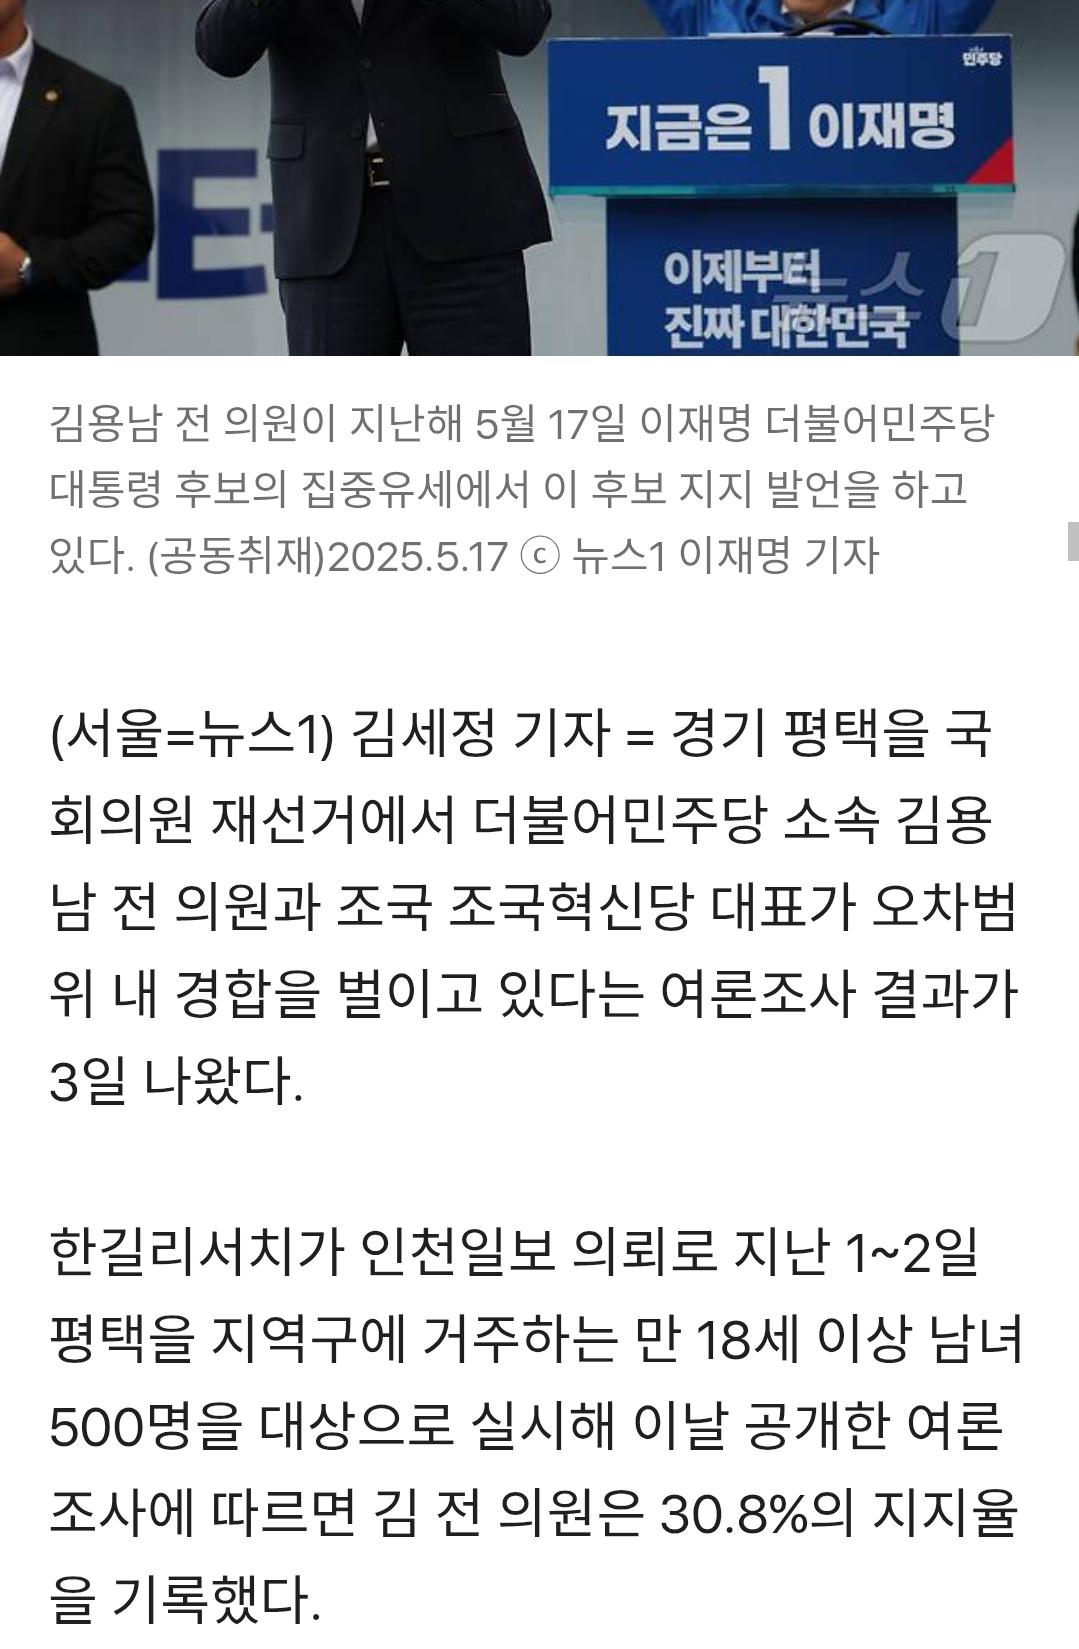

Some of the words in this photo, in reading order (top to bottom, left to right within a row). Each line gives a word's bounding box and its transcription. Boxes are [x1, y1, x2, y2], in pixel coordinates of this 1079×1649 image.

[963, 51, 1003, 66] 민주당
[605, 103, 752, 152] 지금은
[758, 65, 790, 151] 1
[808, 101, 956, 150] 이재명
[664, 248, 821, 294] 이제부터
[665, 304, 745, 349] 진짜
[750, 303, 911, 349] 대한민국
[51, 404, 163, 442] 김용남
[176, 404, 209, 442] 전
[225, 404, 334, 442] 의원이
[351, 404, 460, 442] 지난해
[477, 404, 534, 442] 5월
[549, 404, 624, 442] 17일
[642, 404, 749, 442] 이재명
[768, 404, 995, 442] 더불어민주당
[51, 470, 159, 508] 대통령
[176, 470, 285, 508] 후보의
[303, 470, 527, 508] 집중유세에서
[545, 470, 575, 508] 이
[592, 470, 666, 508] 후보
[680, 470, 750, 508] 지지
[769, 470, 879, 508] 발언을
[893, 470, 966, 508] 하고
[51, 536, 133, 574] 있다.
[149, 536, 508, 577] (공동취재)2025.5.17
[573, 538, 662, 574] 뉴스1
[681, 536, 788, 574] 이재명
[806, 536, 880, 574] 기자
[52, 708, 332, 761] (서울=뉴스1)
[353, 708, 493, 757] 김세정
[515, 708, 611, 757] 기자
[673, 708, 763, 757] 경기
[784, 708, 928, 757] 평택을
[946, 710, 991, 757] 국
[51, 795, 191, 844] 회의원
[212, 795, 452, 844] 재선거에서
[476, 795, 768, 844] 더불어민주당
[785, 796, 879, 844] 소속
[897, 795, 991, 844] 김용
[53, 882, 96, 931] 남
[112, 882, 155, 930] 전
[176, 882, 321, 931] 의원과
[338, 884, 432, 931] 조국
[450, 882, 694, 931] 조국혁신당
[713, 882, 856, 931] 대표가
[873, 882, 1014, 931] 오차범
[50, 969, 91, 1018] 위
[115, 969, 155, 1018] 내
[177, 968, 320, 1018] 경합을
[340, 969, 482, 1018] 벌이고
[500, 969, 644, 1018] 있다는
[662, 969, 856, 1018] 여론조사
[874, 969, 1018, 1018] 결과가
[50, 1056, 125, 1105] 3일
[147, 1056, 302, 1106] 나왔다.
[50, 1227, 345, 1276] 한길리서치가
[362, 1227, 555, 1276] 인천일보
[573, 1227, 717, 1276] 의뢰로
[735, 1227, 830, 1276] 지난
[847, 1227, 976, 1276] 1~2일
[50, 1314, 195, 1363] 평택을
[212, 1314, 404, 1363] 지역구에
[424, 1314, 618, 1363] 거주하는
[638, 1314, 681, 1362] 만
[698, 1314, 797, 1363] 18세
[819, 1314, 913, 1363] 이상
[932, 1314, 1020, 1363] 남녀
[51, 1401, 242, 1450] 500명을
[261, 1401, 454, 1450] 대상으로
[472, 1401, 613, 1450] 실시해
[635, 1401, 729, 1450] 이날
[746, 1401, 891, 1450] 공개한
[908, 1401, 1002, 1450] 여론
[50, 1488, 192, 1537] 조사에
[214, 1488, 354, 1537] 따르면
[374, 1488, 415, 1537] 김
[437, 1488, 479, 1536] 전
[500, 1488, 644, 1537] 의원은
[661, 1488, 851, 1537] 30.8%의
[874, 1488, 1018, 1537] 지지율
[50, 1576, 95, 1624] 을
[114, 1575, 319, 1624] 기록했다.
